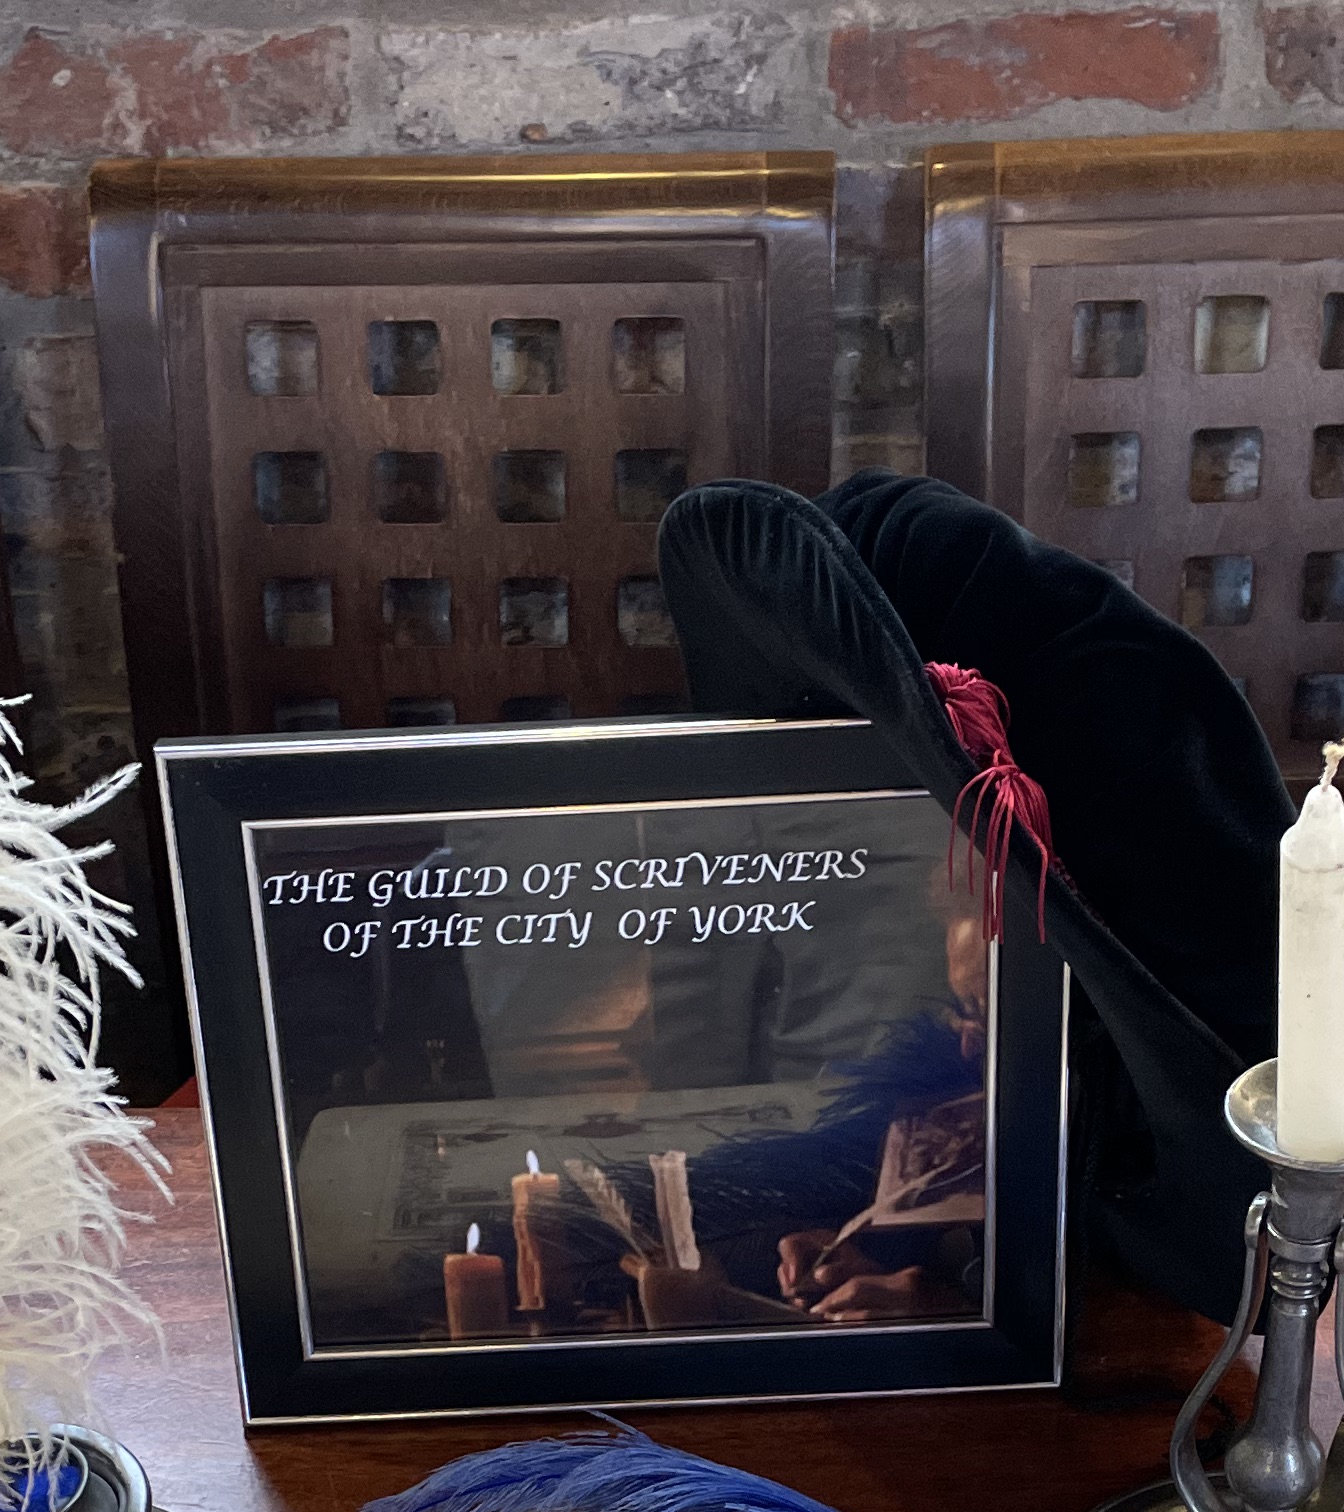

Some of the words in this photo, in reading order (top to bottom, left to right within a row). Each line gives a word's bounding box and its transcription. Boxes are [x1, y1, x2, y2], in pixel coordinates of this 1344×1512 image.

[263, 868, 356, 905] THE
[368, 866, 508, 908] GUILD
[522, 862, 582, 900] OF
[591, 848, 868, 891] SCRIVENERS
[323, 920, 382, 958] OF
[391, 912, 484, 949] THE
[496, 908, 593, 949] CITY
[618, 907, 677, 945] OF
[688, 900, 816, 943] YORK
